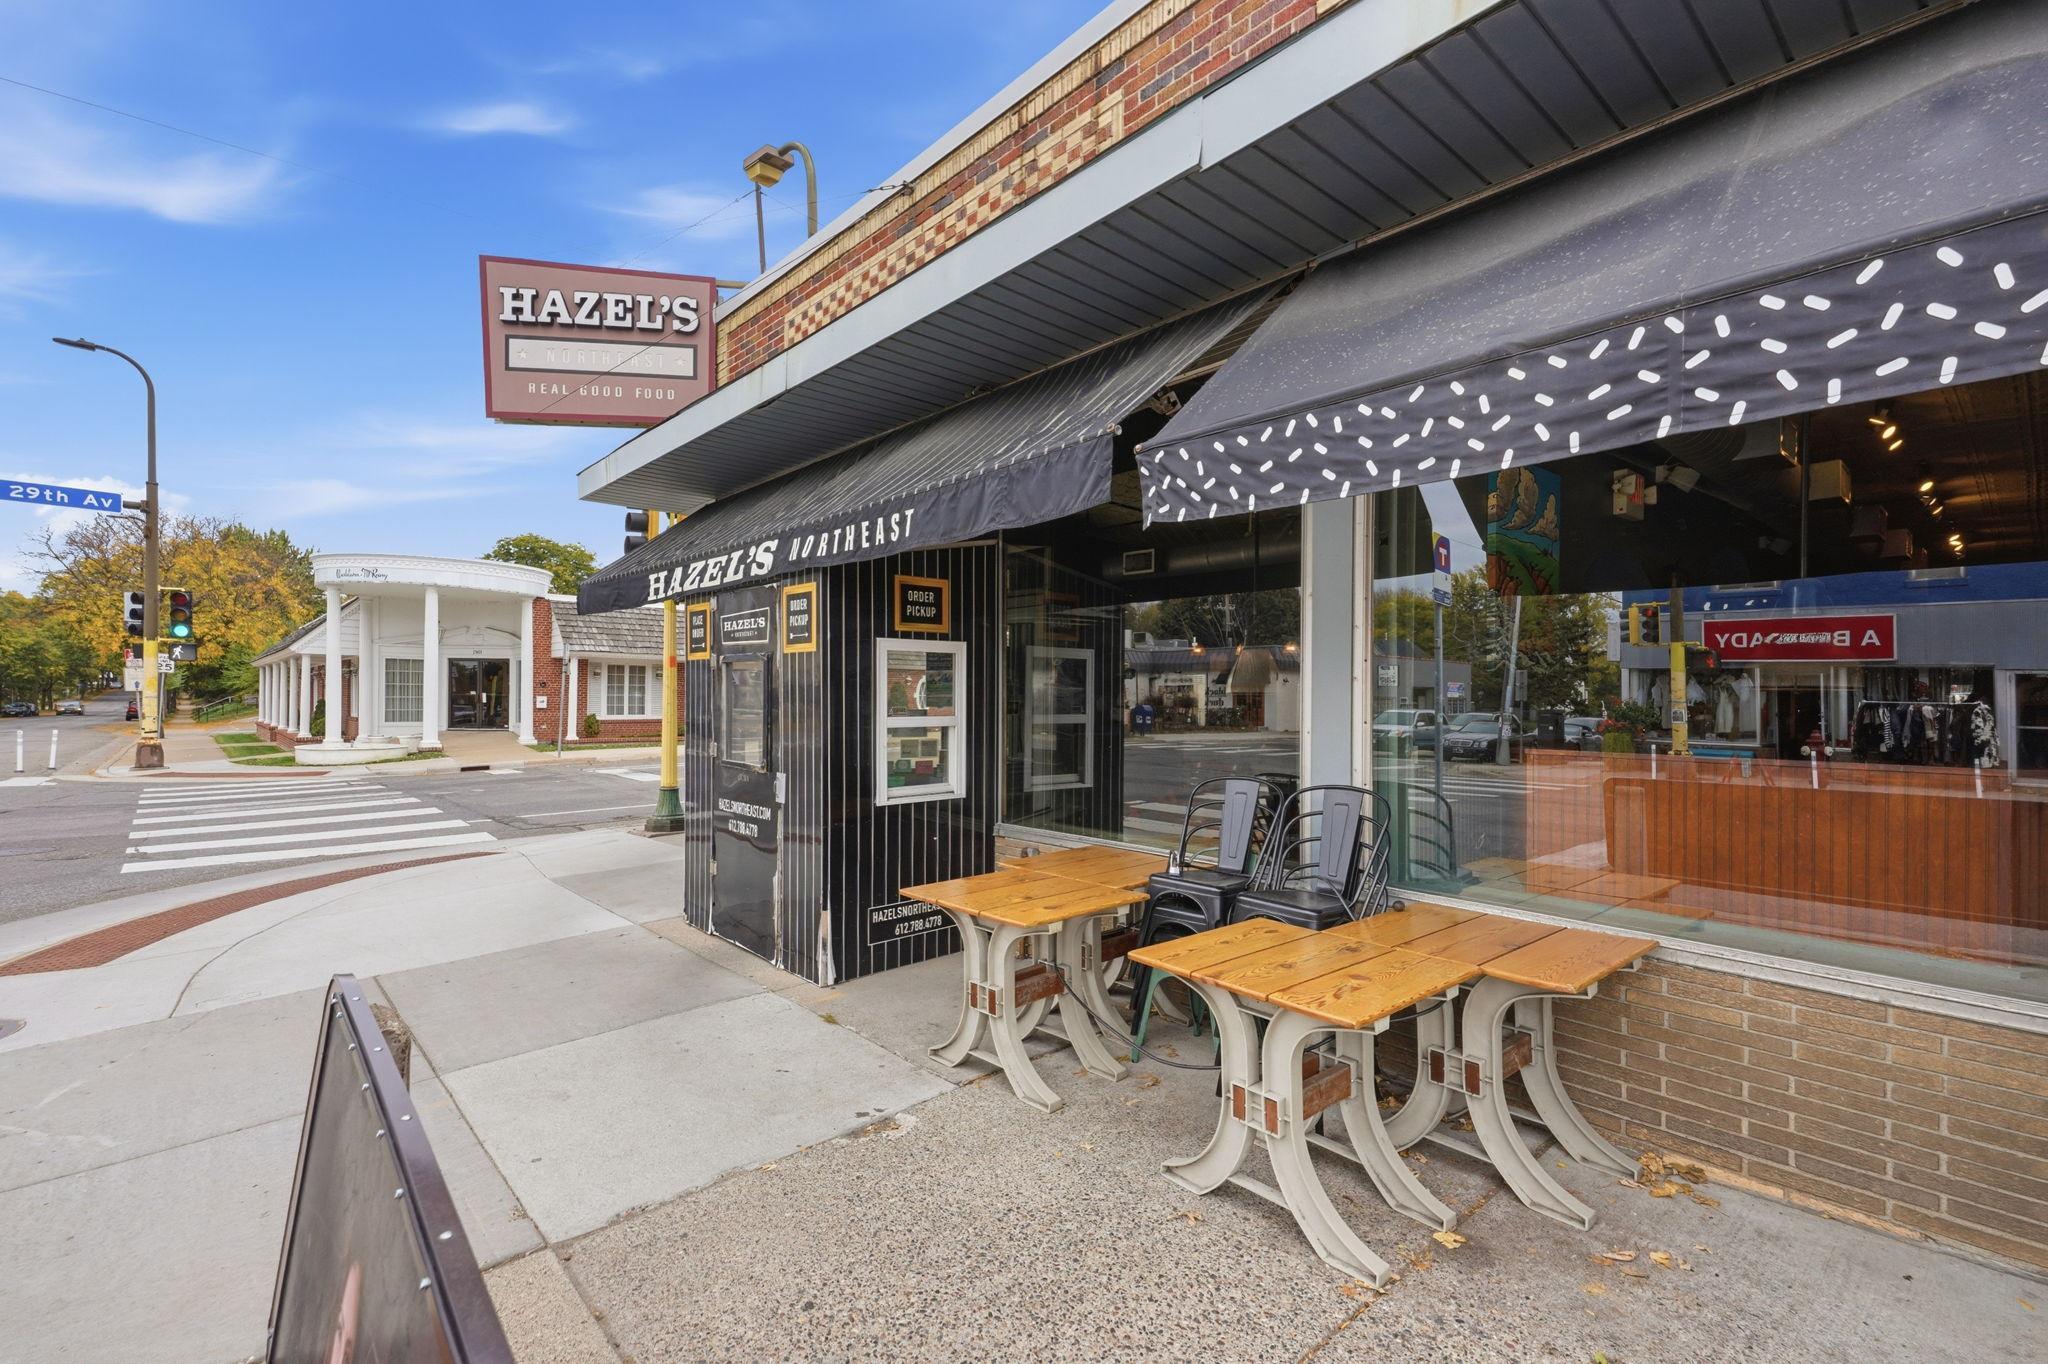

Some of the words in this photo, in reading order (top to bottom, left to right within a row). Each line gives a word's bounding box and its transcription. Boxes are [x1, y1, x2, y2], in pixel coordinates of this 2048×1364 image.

[499, 286, 699, 333] HAZEL'S
[546, 347, 665, 369] NORTHEAST
[528, 382, 569, 396] REAL
[579, 384, 623, 398] GOOD
[635, 387, 675, 401] FOOD
[9, 485, 69, 503] 29th
[82, 494, 113, 508] Av
[647, 538, 779, 601] HAZEL'S
[788, 508, 915, 562] NORTHEAST
[790, 598, 808, 612] ORDER
[907, 590, 935, 604] ORDER
[789, 613, 809, 628] PICKUP
[906, 605, 937, 618] PICKUP
[723, 616, 766, 632] HAZEL'S
[894, 915, 942, 936] 612.788.4778
